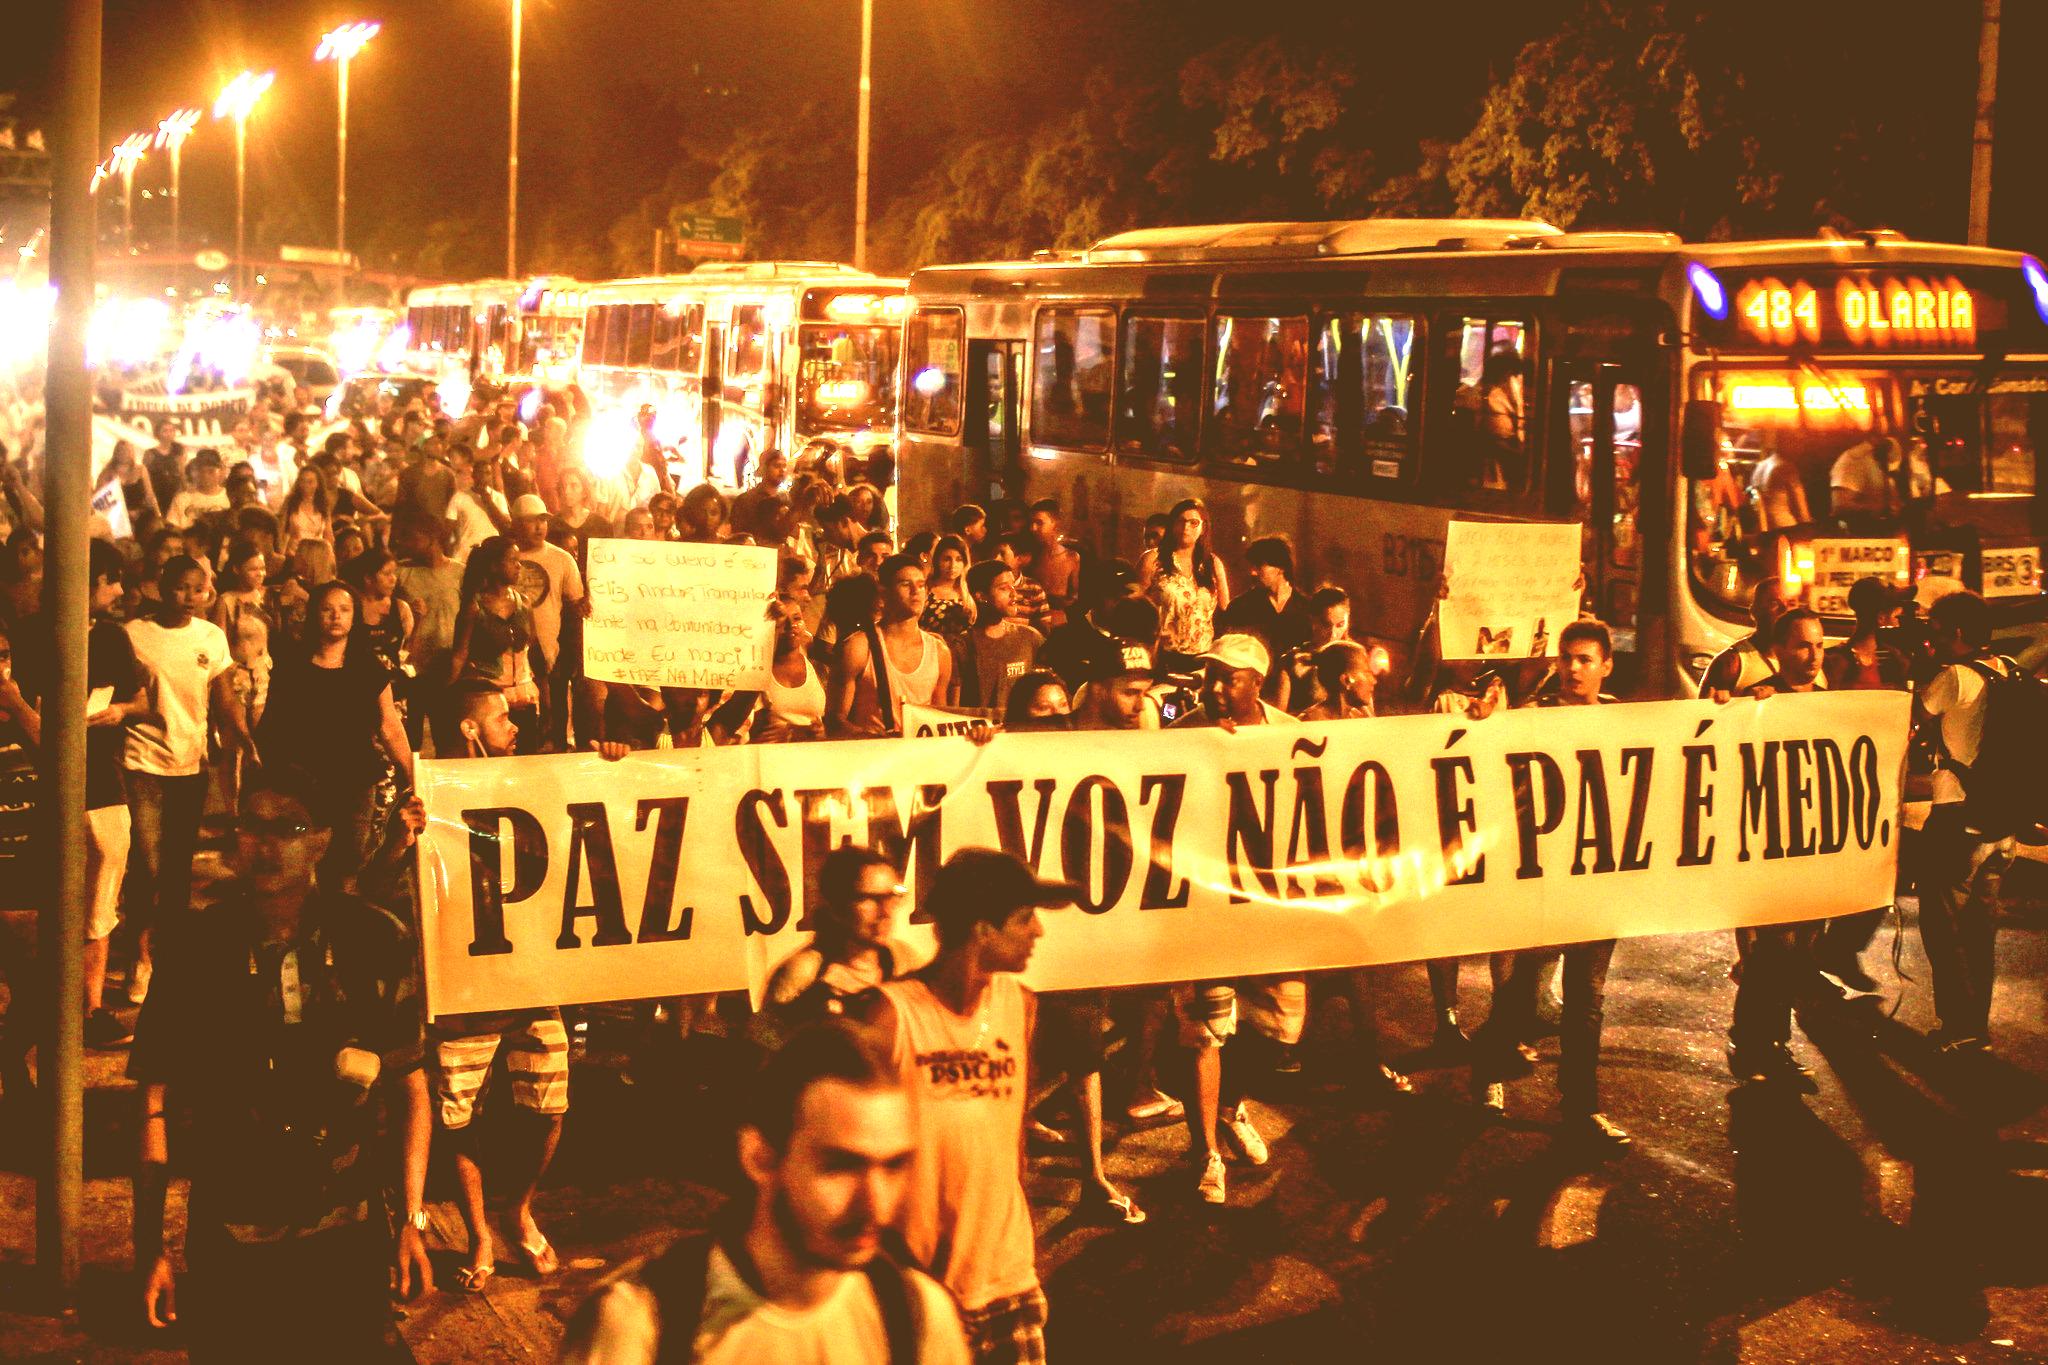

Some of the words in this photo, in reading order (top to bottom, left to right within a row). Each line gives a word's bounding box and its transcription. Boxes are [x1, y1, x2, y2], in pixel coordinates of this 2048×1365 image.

[1745, 288, 1818, 329] 484
[1843, 288, 1974, 329] OLARIA
[651, 644, 676, 663] Eu
[460, 795, 693, 957] PAZ
[736, 783, 949, 937] SEM
[985, 773, 1191, 915] VOZ
[1225, 735, 1402, 906] NÃO
[1430, 728, 1488, 887] É
[1505, 746, 1656, 881] PAZ
[1675, 718, 1717, 867] É
[1737, 733, 1892, 864] MEDO.
